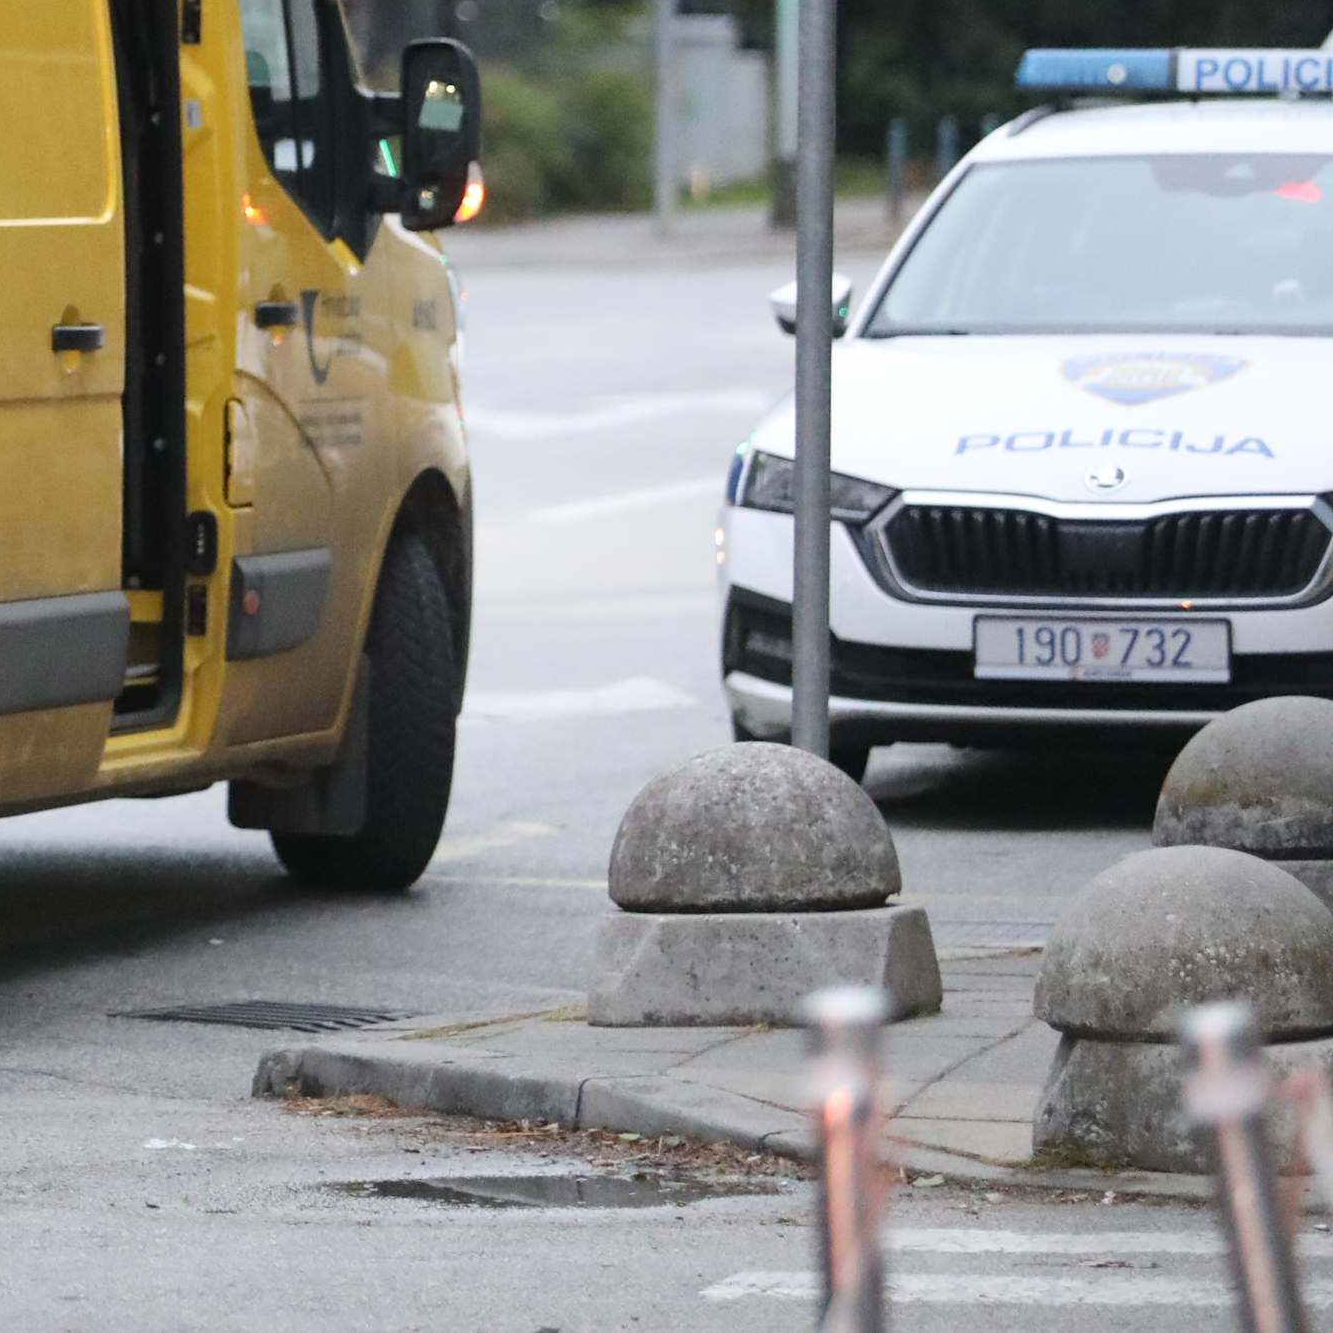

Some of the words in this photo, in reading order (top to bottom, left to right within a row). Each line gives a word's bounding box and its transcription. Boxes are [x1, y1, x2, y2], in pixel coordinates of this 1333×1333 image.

[954, 428, 1276, 459] POLICIJA
[1015, 626, 1082, 667] 190
[1118, 627, 1193, 668] 732
